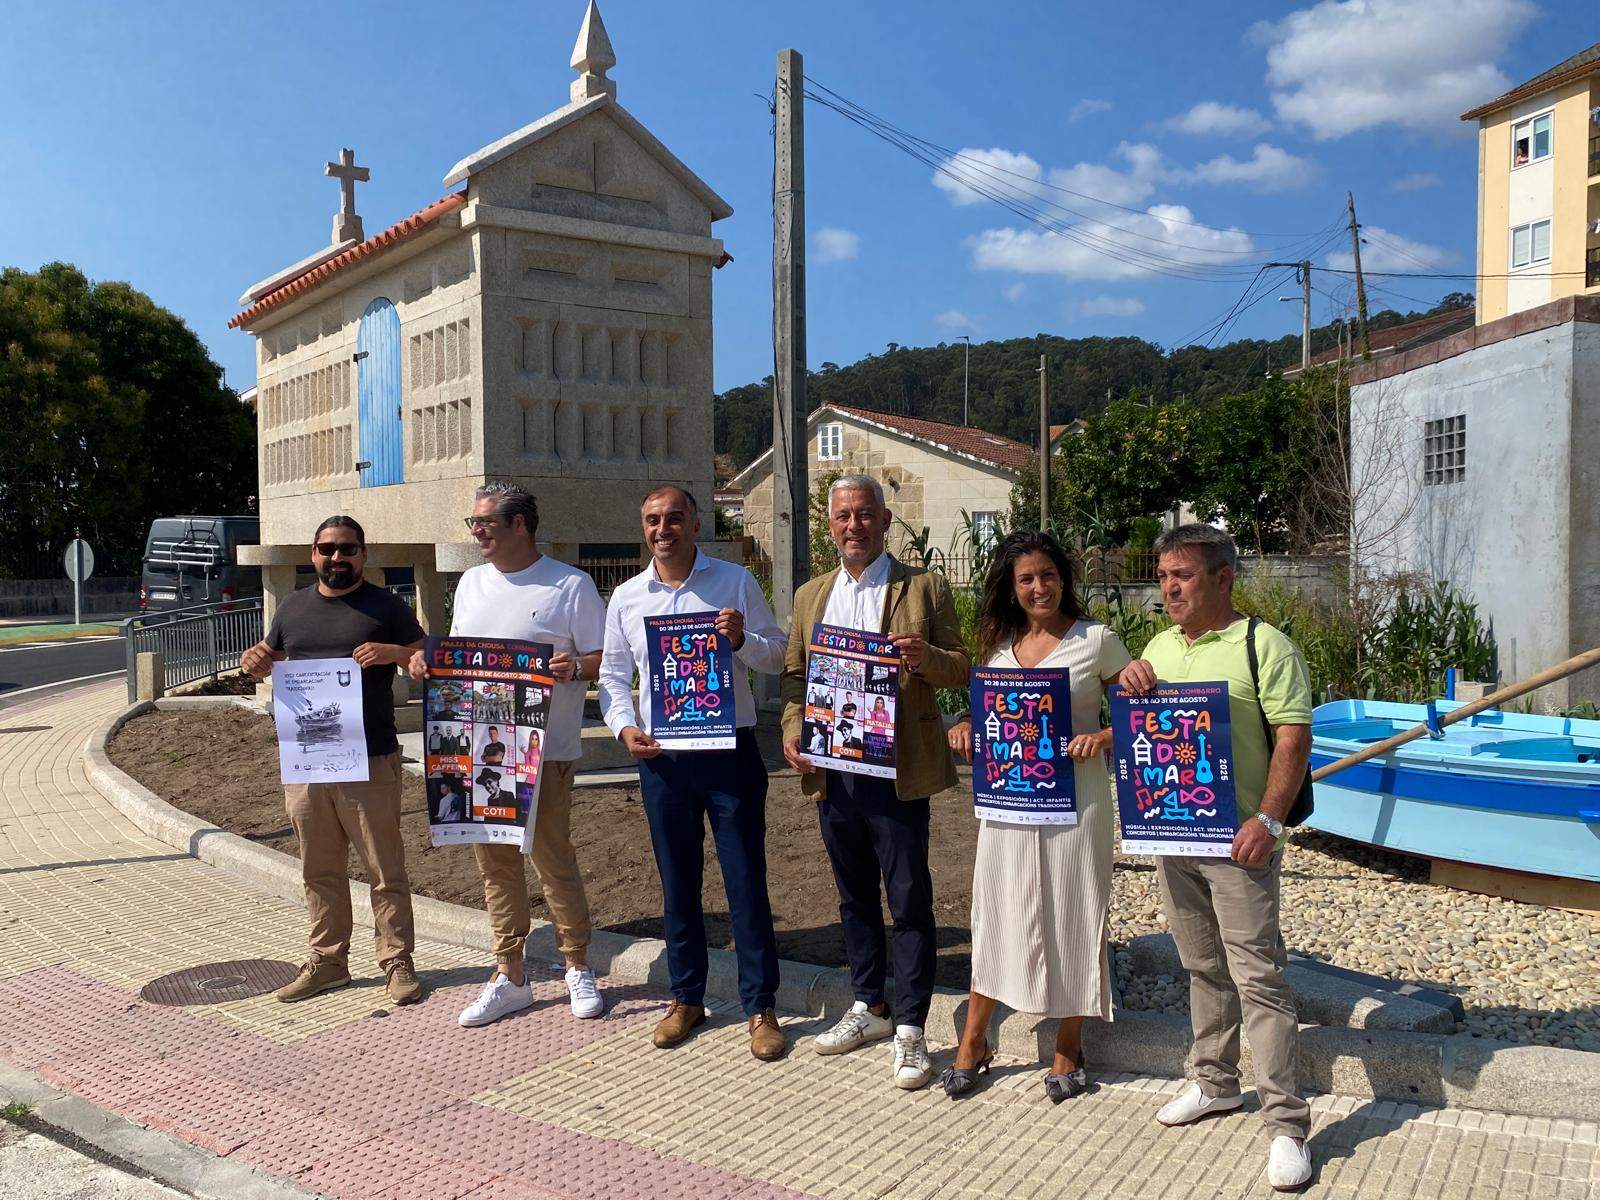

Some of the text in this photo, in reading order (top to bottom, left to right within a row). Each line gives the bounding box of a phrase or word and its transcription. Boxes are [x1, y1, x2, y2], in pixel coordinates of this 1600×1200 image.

[660, 633, 718, 657] FESTA
[817, 632, 846, 648] FESTA
[868, 642, 893, 654] MAR
[433, 649, 482, 666] FESTA
[517, 654, 542, 670] MAR
[670, 677, 706, 695] MAR
[983, 690, 1054, 719] FESTA
[1129, 710, 1211, 739] FESTA
[992, 740, 1037, 760] MAR
[1060, 736, 1068, 757] 2025
[1120, 759, 1128, 780] 2025
[1143, 764, 1194, 785] MAR
[1220, 759, 1228, 781] 2025
[483, 808, 506, 816] COTI
